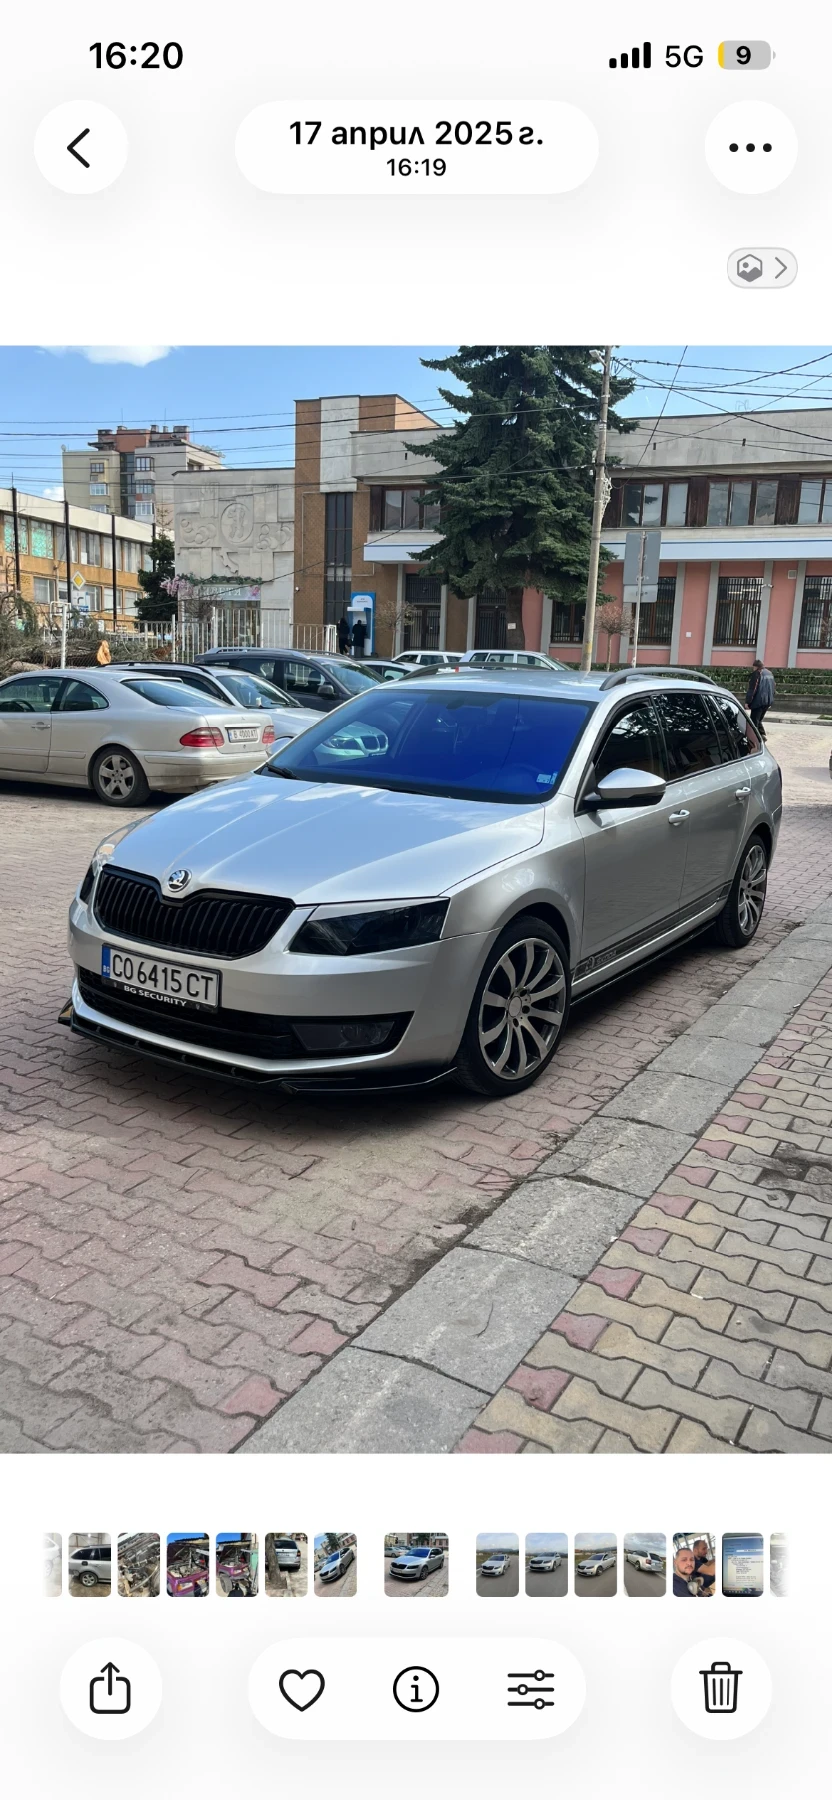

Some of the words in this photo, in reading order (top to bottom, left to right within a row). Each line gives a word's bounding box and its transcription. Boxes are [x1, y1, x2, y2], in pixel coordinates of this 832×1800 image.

[113, 954, 134, 980] CO
[138, 961, 182, 992] 6415
[187, 973, 214, 1000] CT
[124, 985, 137, 994] BG
[138, 989, 187, 1007] SECURITY
